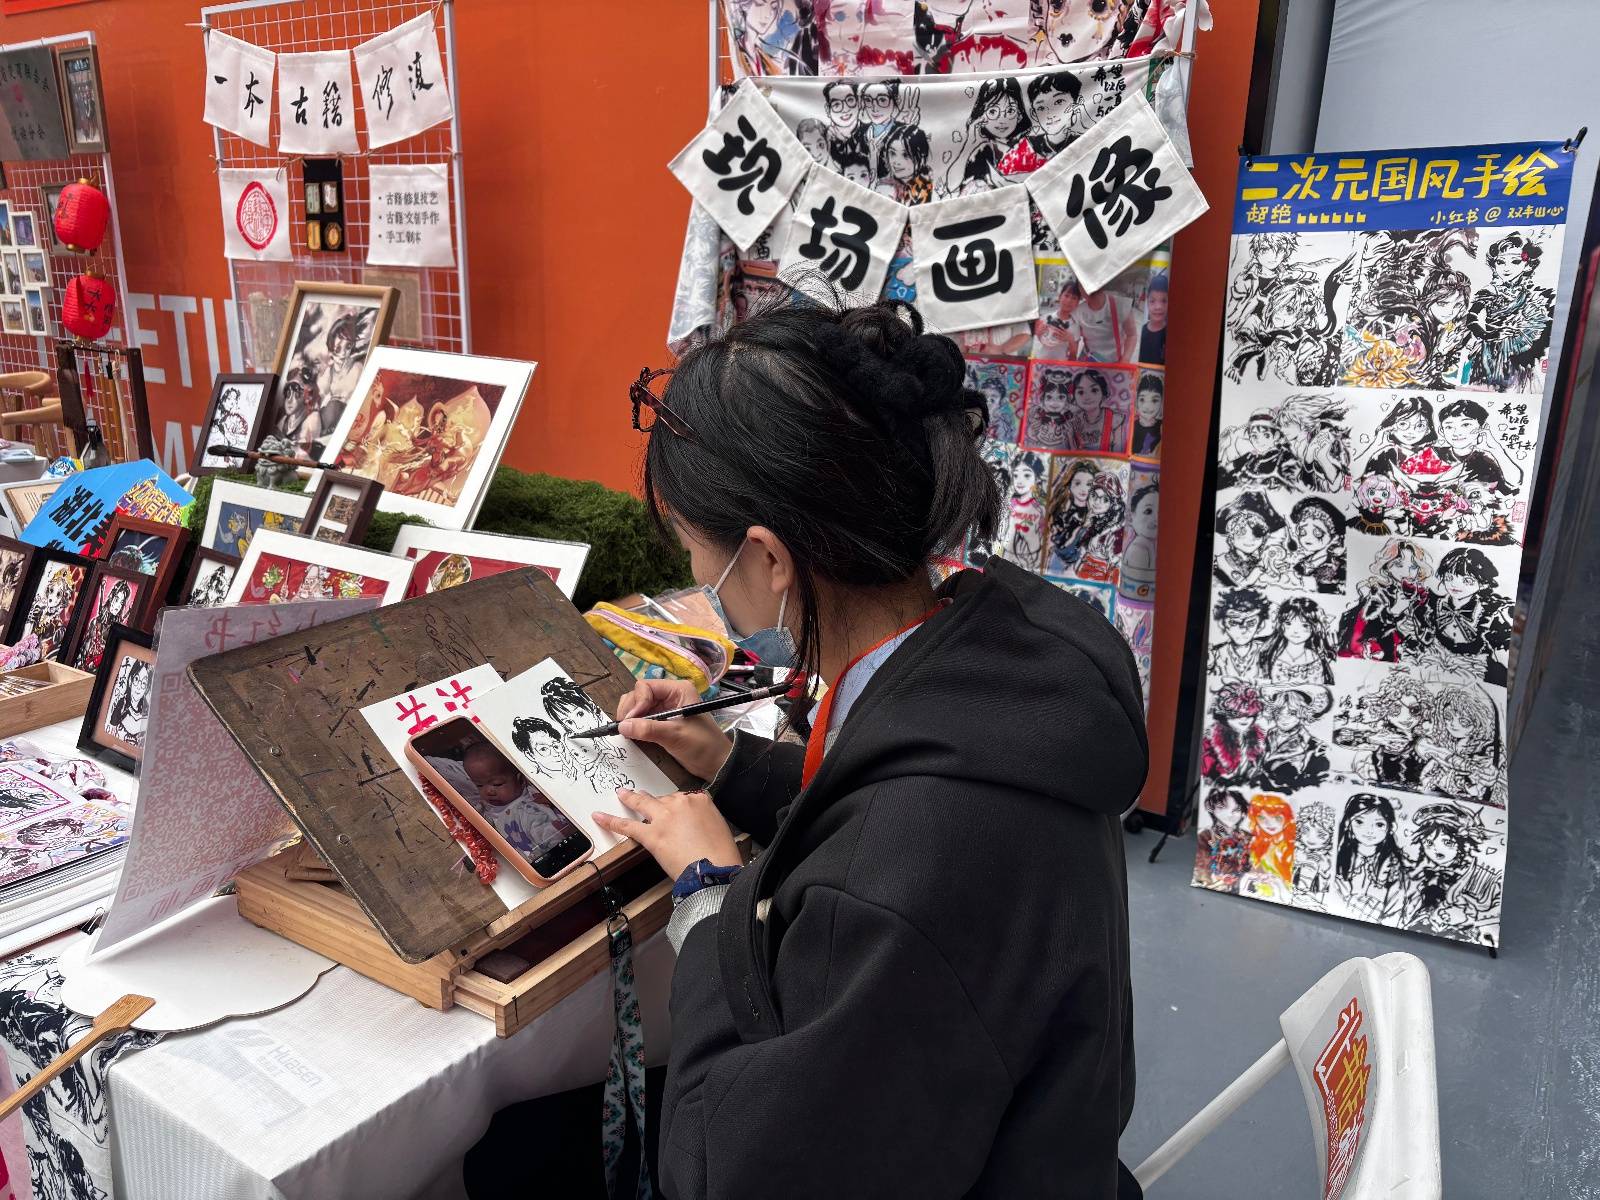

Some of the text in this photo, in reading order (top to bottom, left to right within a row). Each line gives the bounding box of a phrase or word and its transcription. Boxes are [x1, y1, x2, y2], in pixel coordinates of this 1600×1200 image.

[1242, 149, 1559, 202] 二次元国风手绘
[1498, 403, 1528, 419] 希望
[1509, 415, 1529, 425] 以后
[1509, 425, 1525, 436] 一直
